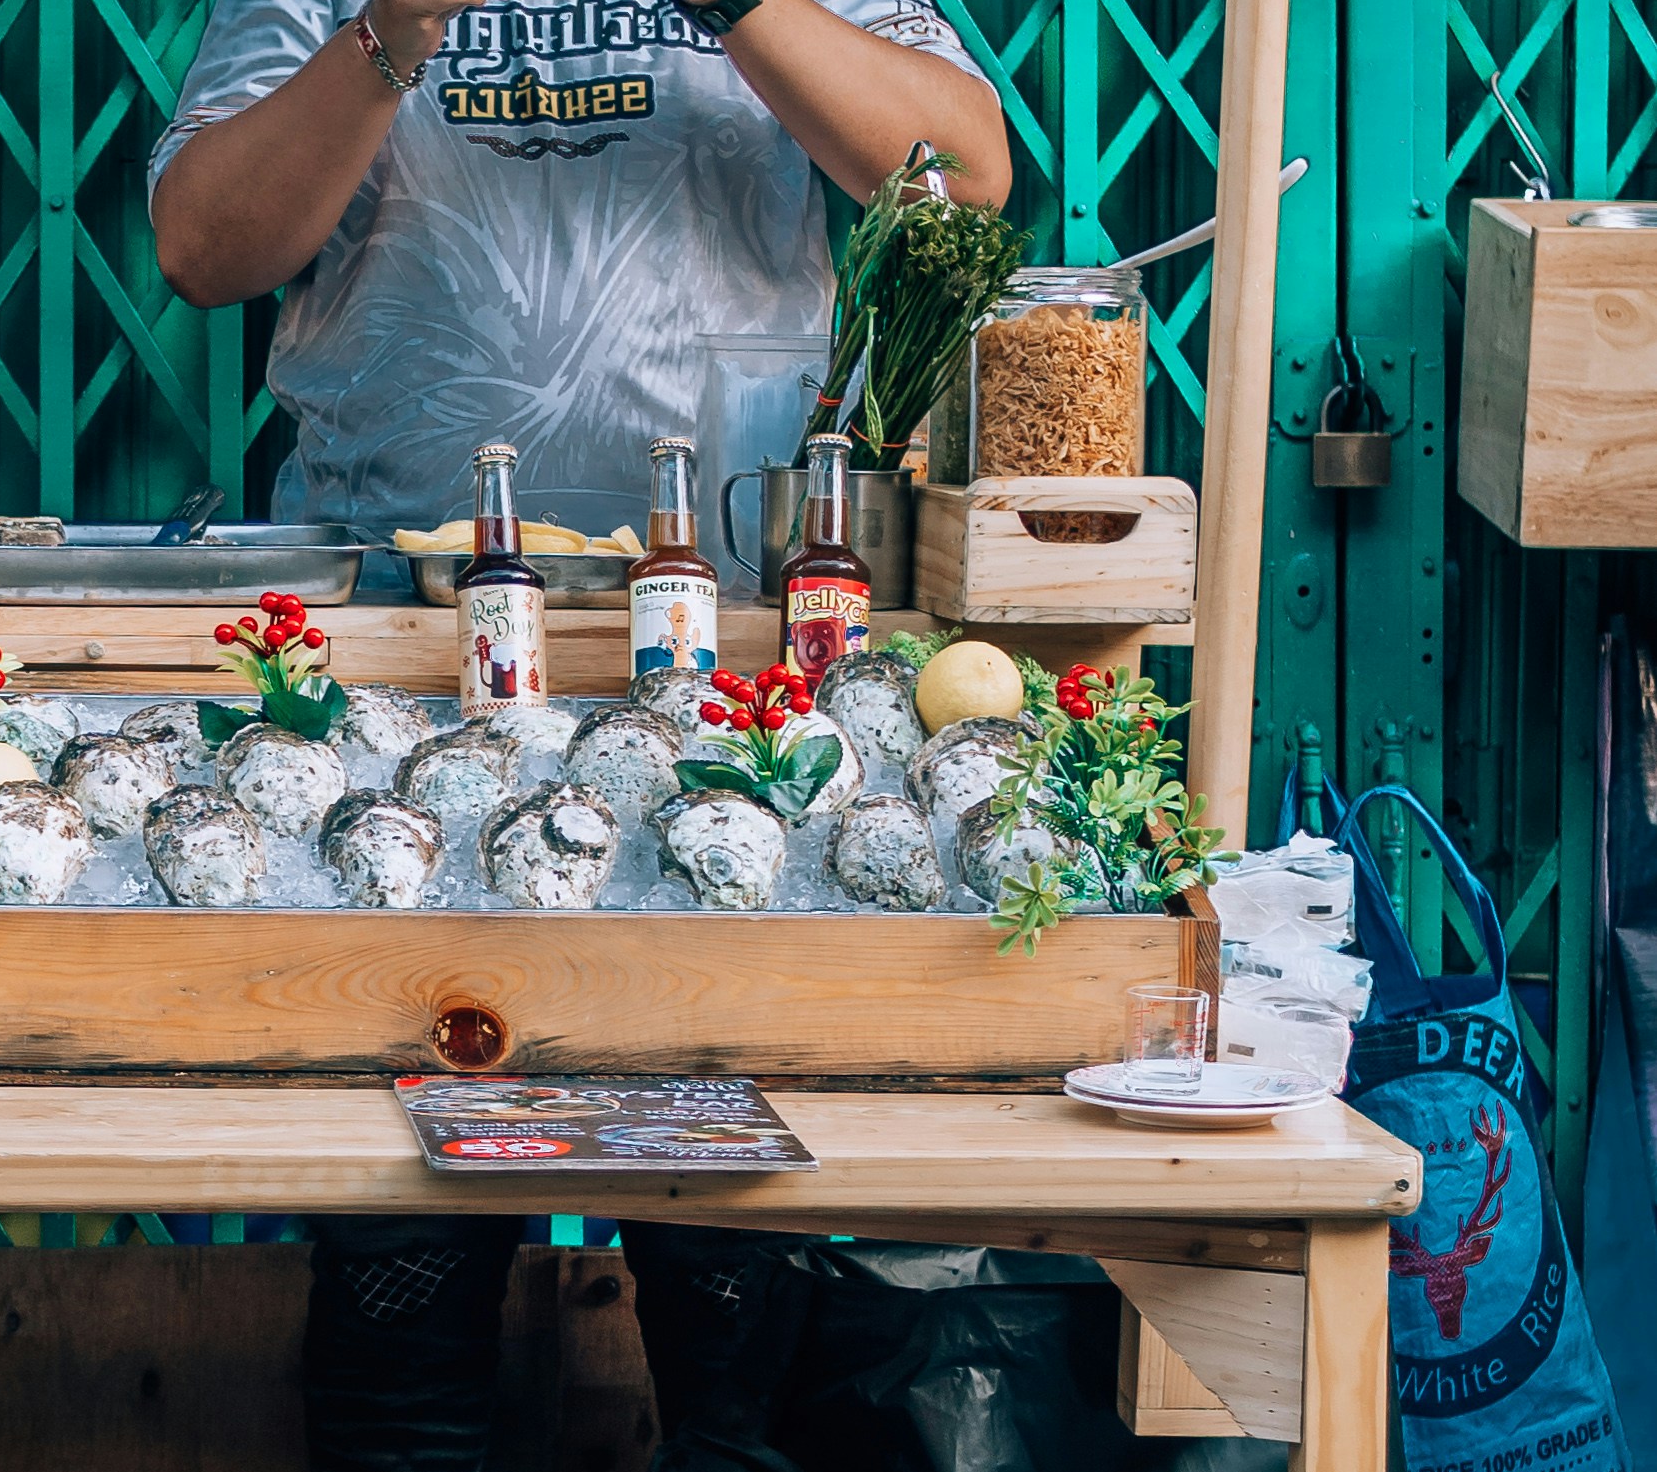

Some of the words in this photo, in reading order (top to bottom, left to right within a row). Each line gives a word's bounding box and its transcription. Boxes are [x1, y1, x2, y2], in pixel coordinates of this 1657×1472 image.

[635, 582, 690, 596] GINGER
[695, 584, 715, 598] TEA
[470, 592, 515, 625] Root
[493, 616, 535, 641] Day
[578, 1090, 756, 1102] OYSTER
[672, 1100, 762, 1110] BAR
[460, 1143, 557, 1154] 50
[1395, 1358, 1507, 1404] White
[1520, 1263, 1562, 1347] Rice
[1536, 1420, 1601, 1461] GRADE
